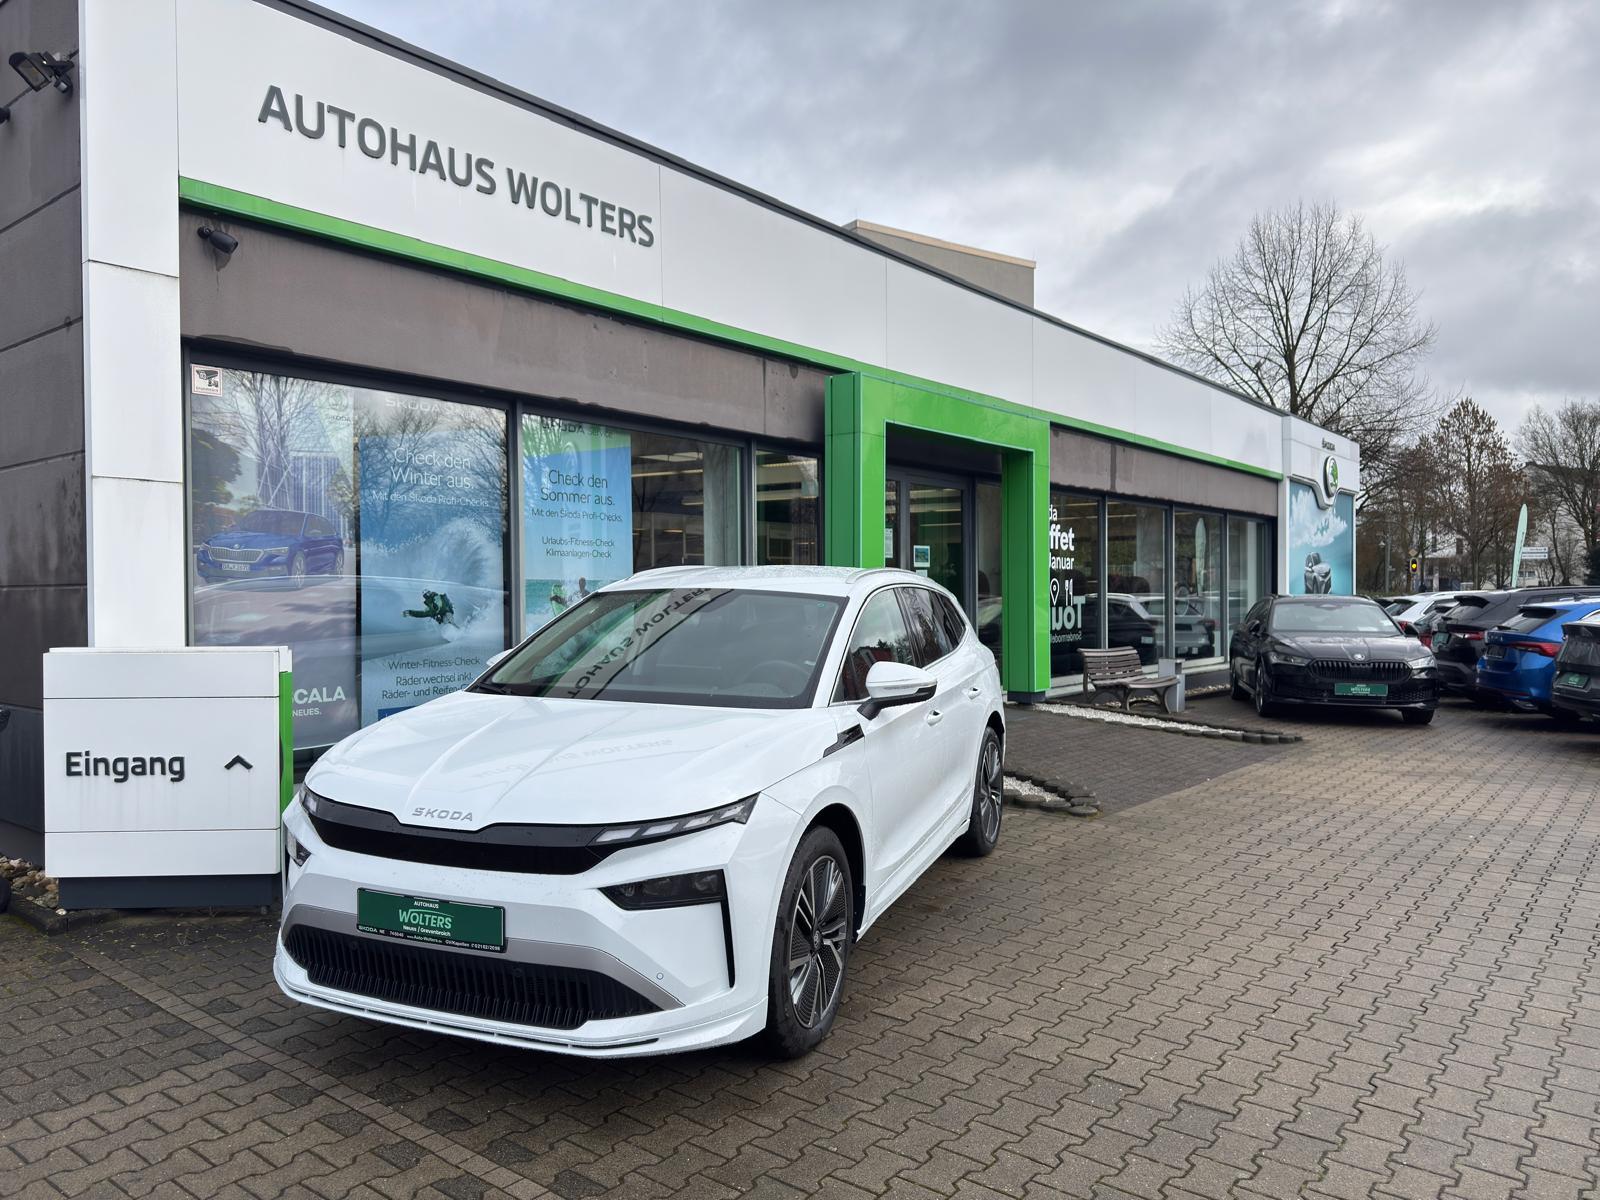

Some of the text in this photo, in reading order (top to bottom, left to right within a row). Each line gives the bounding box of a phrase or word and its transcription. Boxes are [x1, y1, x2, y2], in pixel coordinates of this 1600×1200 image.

[258, 85, 655, 248] AUTOHAUS WOLTERS
[394, 447, 472, 469] Check den
[390, 465, 474, 489] Winter aus.
[548, 469, 608, 488] Check den
[372, 490, 388, 501] Mit
[390, 490, 407, 501] den
[541, 487, 615, 506] Sommer aus.
[531, 508, 544, 517] Mit
[545, 508, 559, 518] den
[542, 536, 615, 547] Urlaubs-Fitness-Check
[545, 548, 612, 559] Klimaanlagen-Check
[388, 656, 480, 670] Winter-Fitness-Check
[395, 672, 474, 686] Räderwechsel inkl.
[292, 686, 346, 704] CALA
[382, 690, 411, 700] Räder-
[413, 686, 431, 697] und
[65, 750, 186, 783] Eingang
[414, 901, 440, 909] AUTOHAUS
[399, 908, 453, 929] WOLTERS
